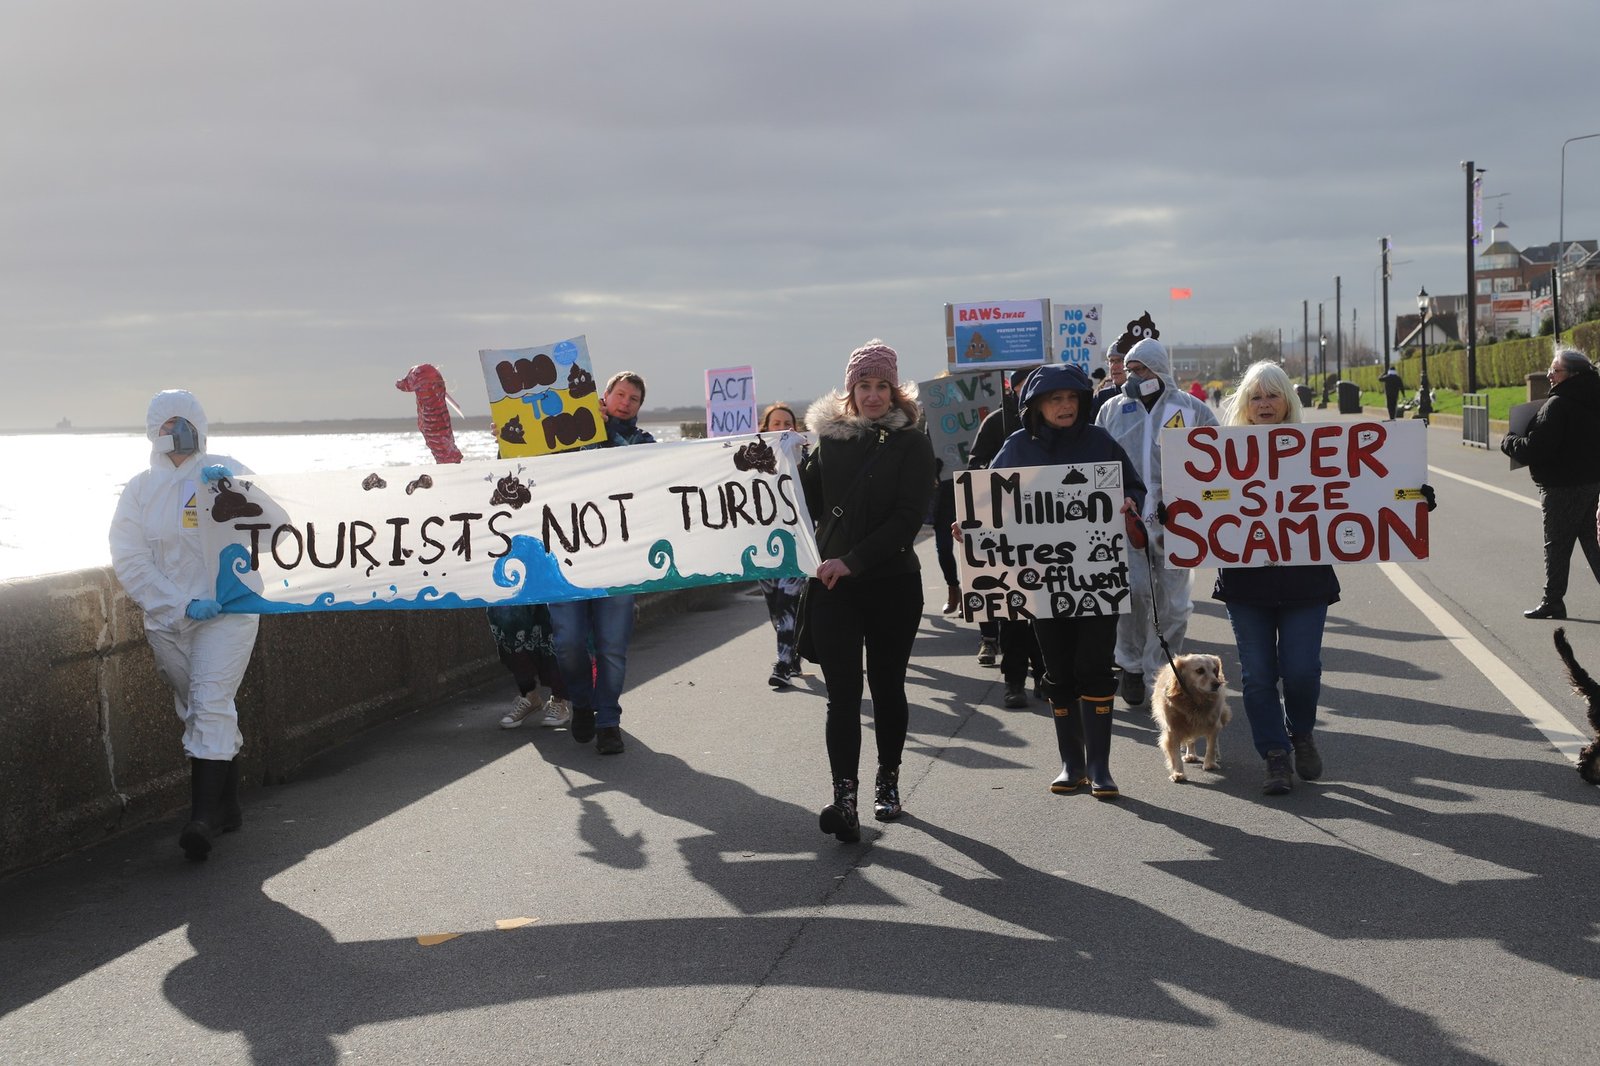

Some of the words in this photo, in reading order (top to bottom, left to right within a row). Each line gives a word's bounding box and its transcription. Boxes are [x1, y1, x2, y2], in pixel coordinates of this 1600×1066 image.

[1060, 322, 1087, 335] POO
[1064, 309, 1083, 320] NO
[1061, 347, 1090, 362] OUR
[1066, 336, 1081, 348] IN
[710, 376, 753, 401] ACT
[521, 390, 563, 420] TO
[711, 406, 753, 432] NOW
[1184, 422, 1389, 482] SUPER
[956, 472, 983, 529] 1
[990, 472, 1113, 529] Million
[1240, 480, 1350, 517] SIZE
[234, 510, 513, 572] TOURISTS
[541, 492, 634, 553] NOT
[668, 473, 798, 531] TURDS
[1164, 497, 1429, 568] SCAMON
[964, 533, 1077, 568] Litres
[1087, 533, 1123, 563] of
[1017, 561, 1129, 593] effluent
[964, 589, 1037, 623] PER
[1050, 588, 1130, 618] DAY
